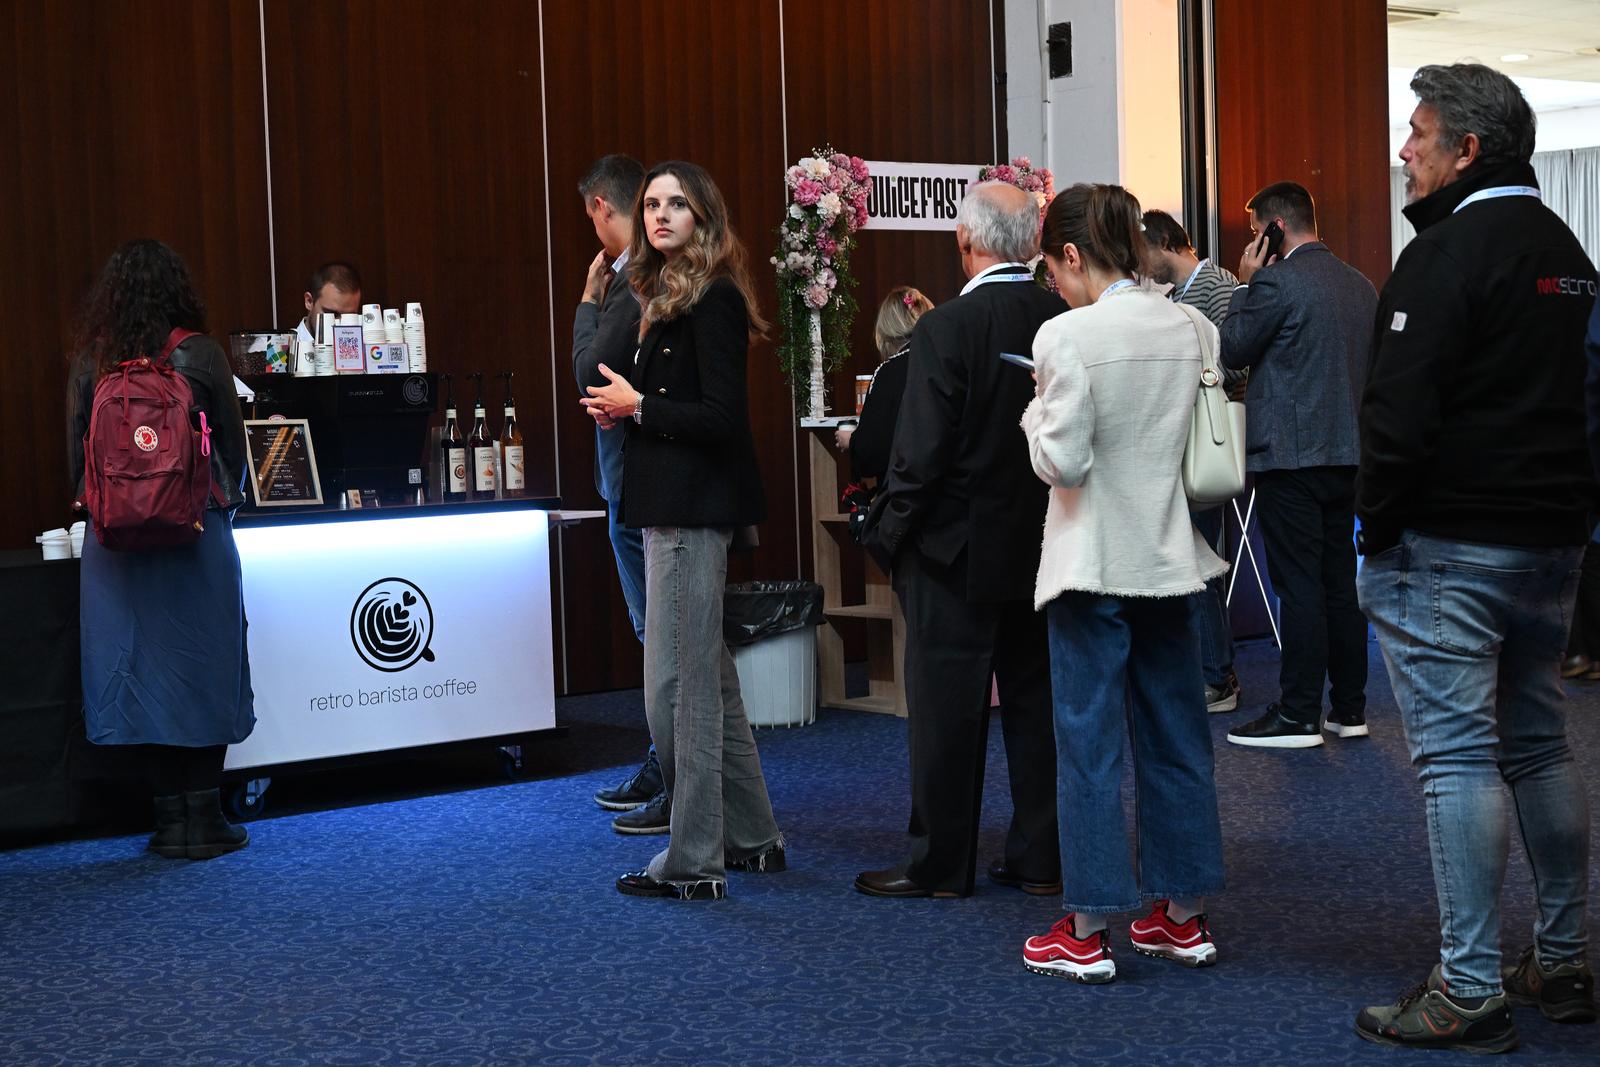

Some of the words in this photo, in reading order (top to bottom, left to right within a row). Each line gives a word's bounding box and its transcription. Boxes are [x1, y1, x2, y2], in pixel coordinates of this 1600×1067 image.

[310, 692, 353, 711] retro
[358, 685, 418, 706] barista
[423, 679, 477, 699] coffee
